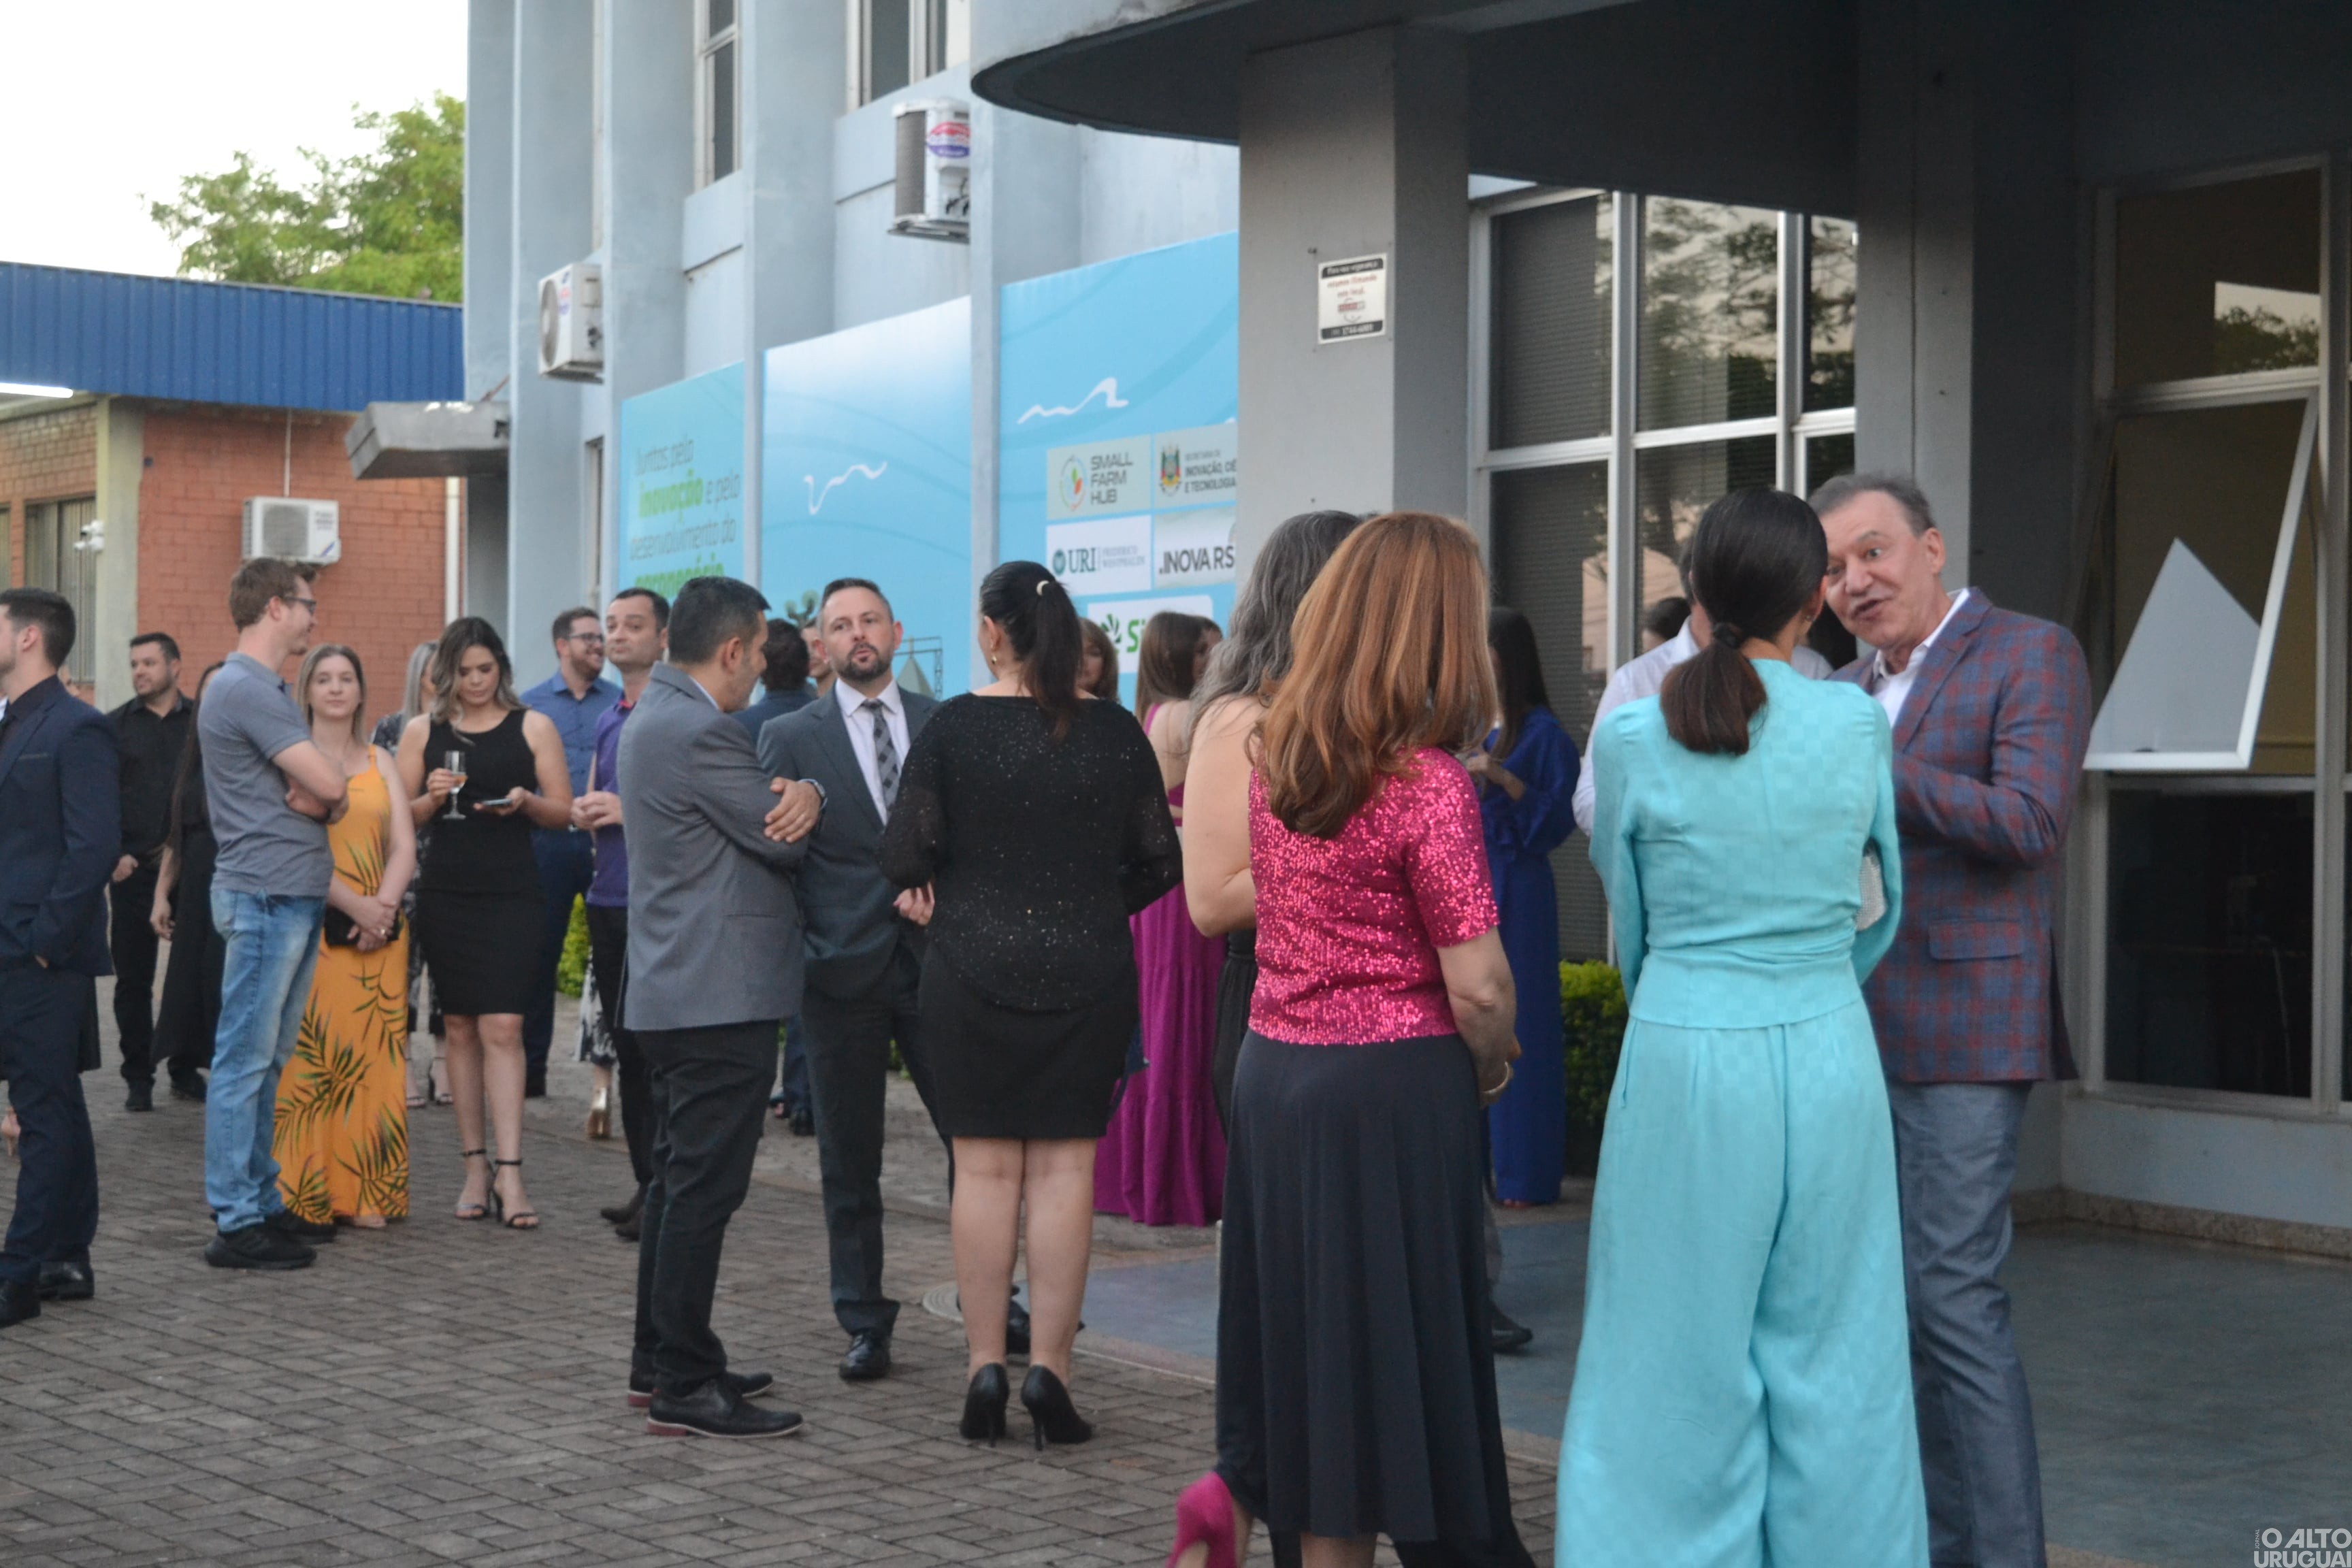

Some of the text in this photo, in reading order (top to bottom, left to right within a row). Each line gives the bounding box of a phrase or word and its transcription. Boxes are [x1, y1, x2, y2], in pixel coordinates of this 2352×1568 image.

[1091, 452, 1134, 471] SMALL
[1090, 470, 1127, 488] FARM
[1090, 489, 1117, 506] HUB
[1068, 547, 1096, 574] URI
[1213, 545, 1235, 570] RS
